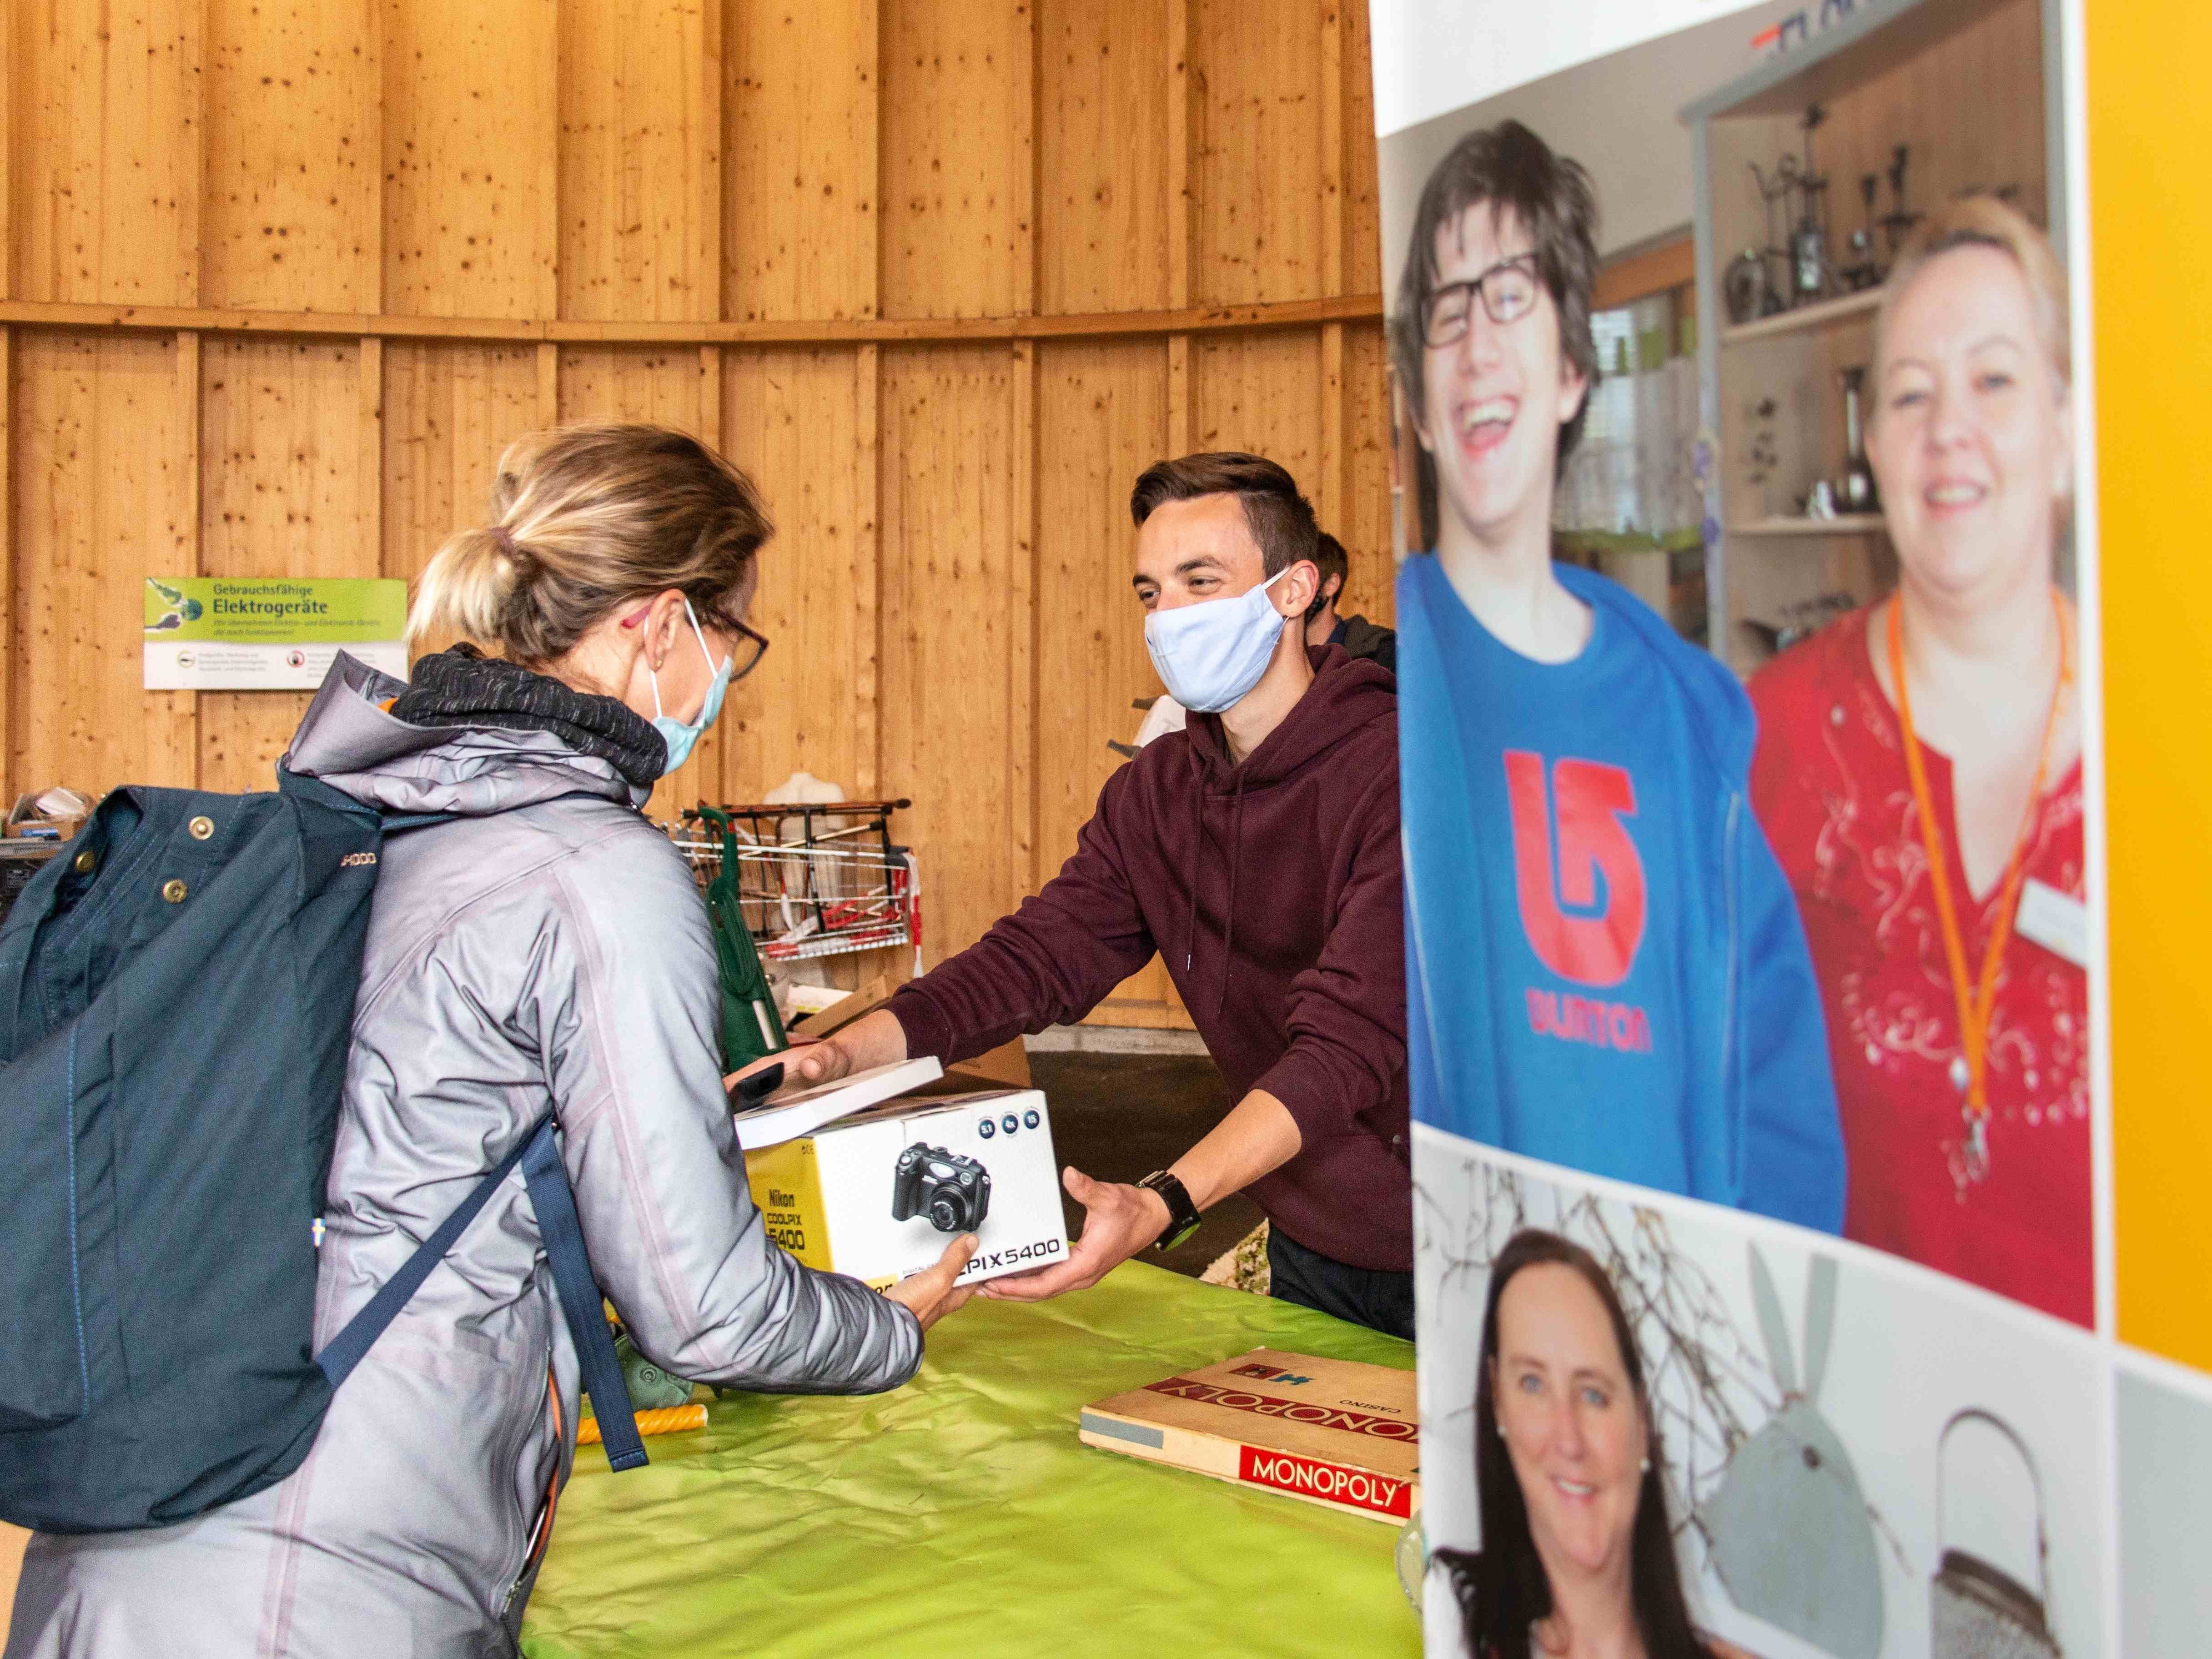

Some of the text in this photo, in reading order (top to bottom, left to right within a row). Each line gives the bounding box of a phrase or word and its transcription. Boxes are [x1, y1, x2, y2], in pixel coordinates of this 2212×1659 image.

[213, 583, 313, 597] Gebrauchsfähige
[213, 598, 328, 618] Elektrogeräte
[769, 1189, 794, 1207] Nikon
[766, 1212, 802, 1226] COOLPIX
[769, 1228, 805, 1250] 5400
[1005, 1238, 1060, 1264] 5400
[1159, 1382, 1418, 1442] ONOPOLY
[1339, 1399, 1401, 1413] CASINO
[1252, 1454, 1397, 1507] MONOPOLY
